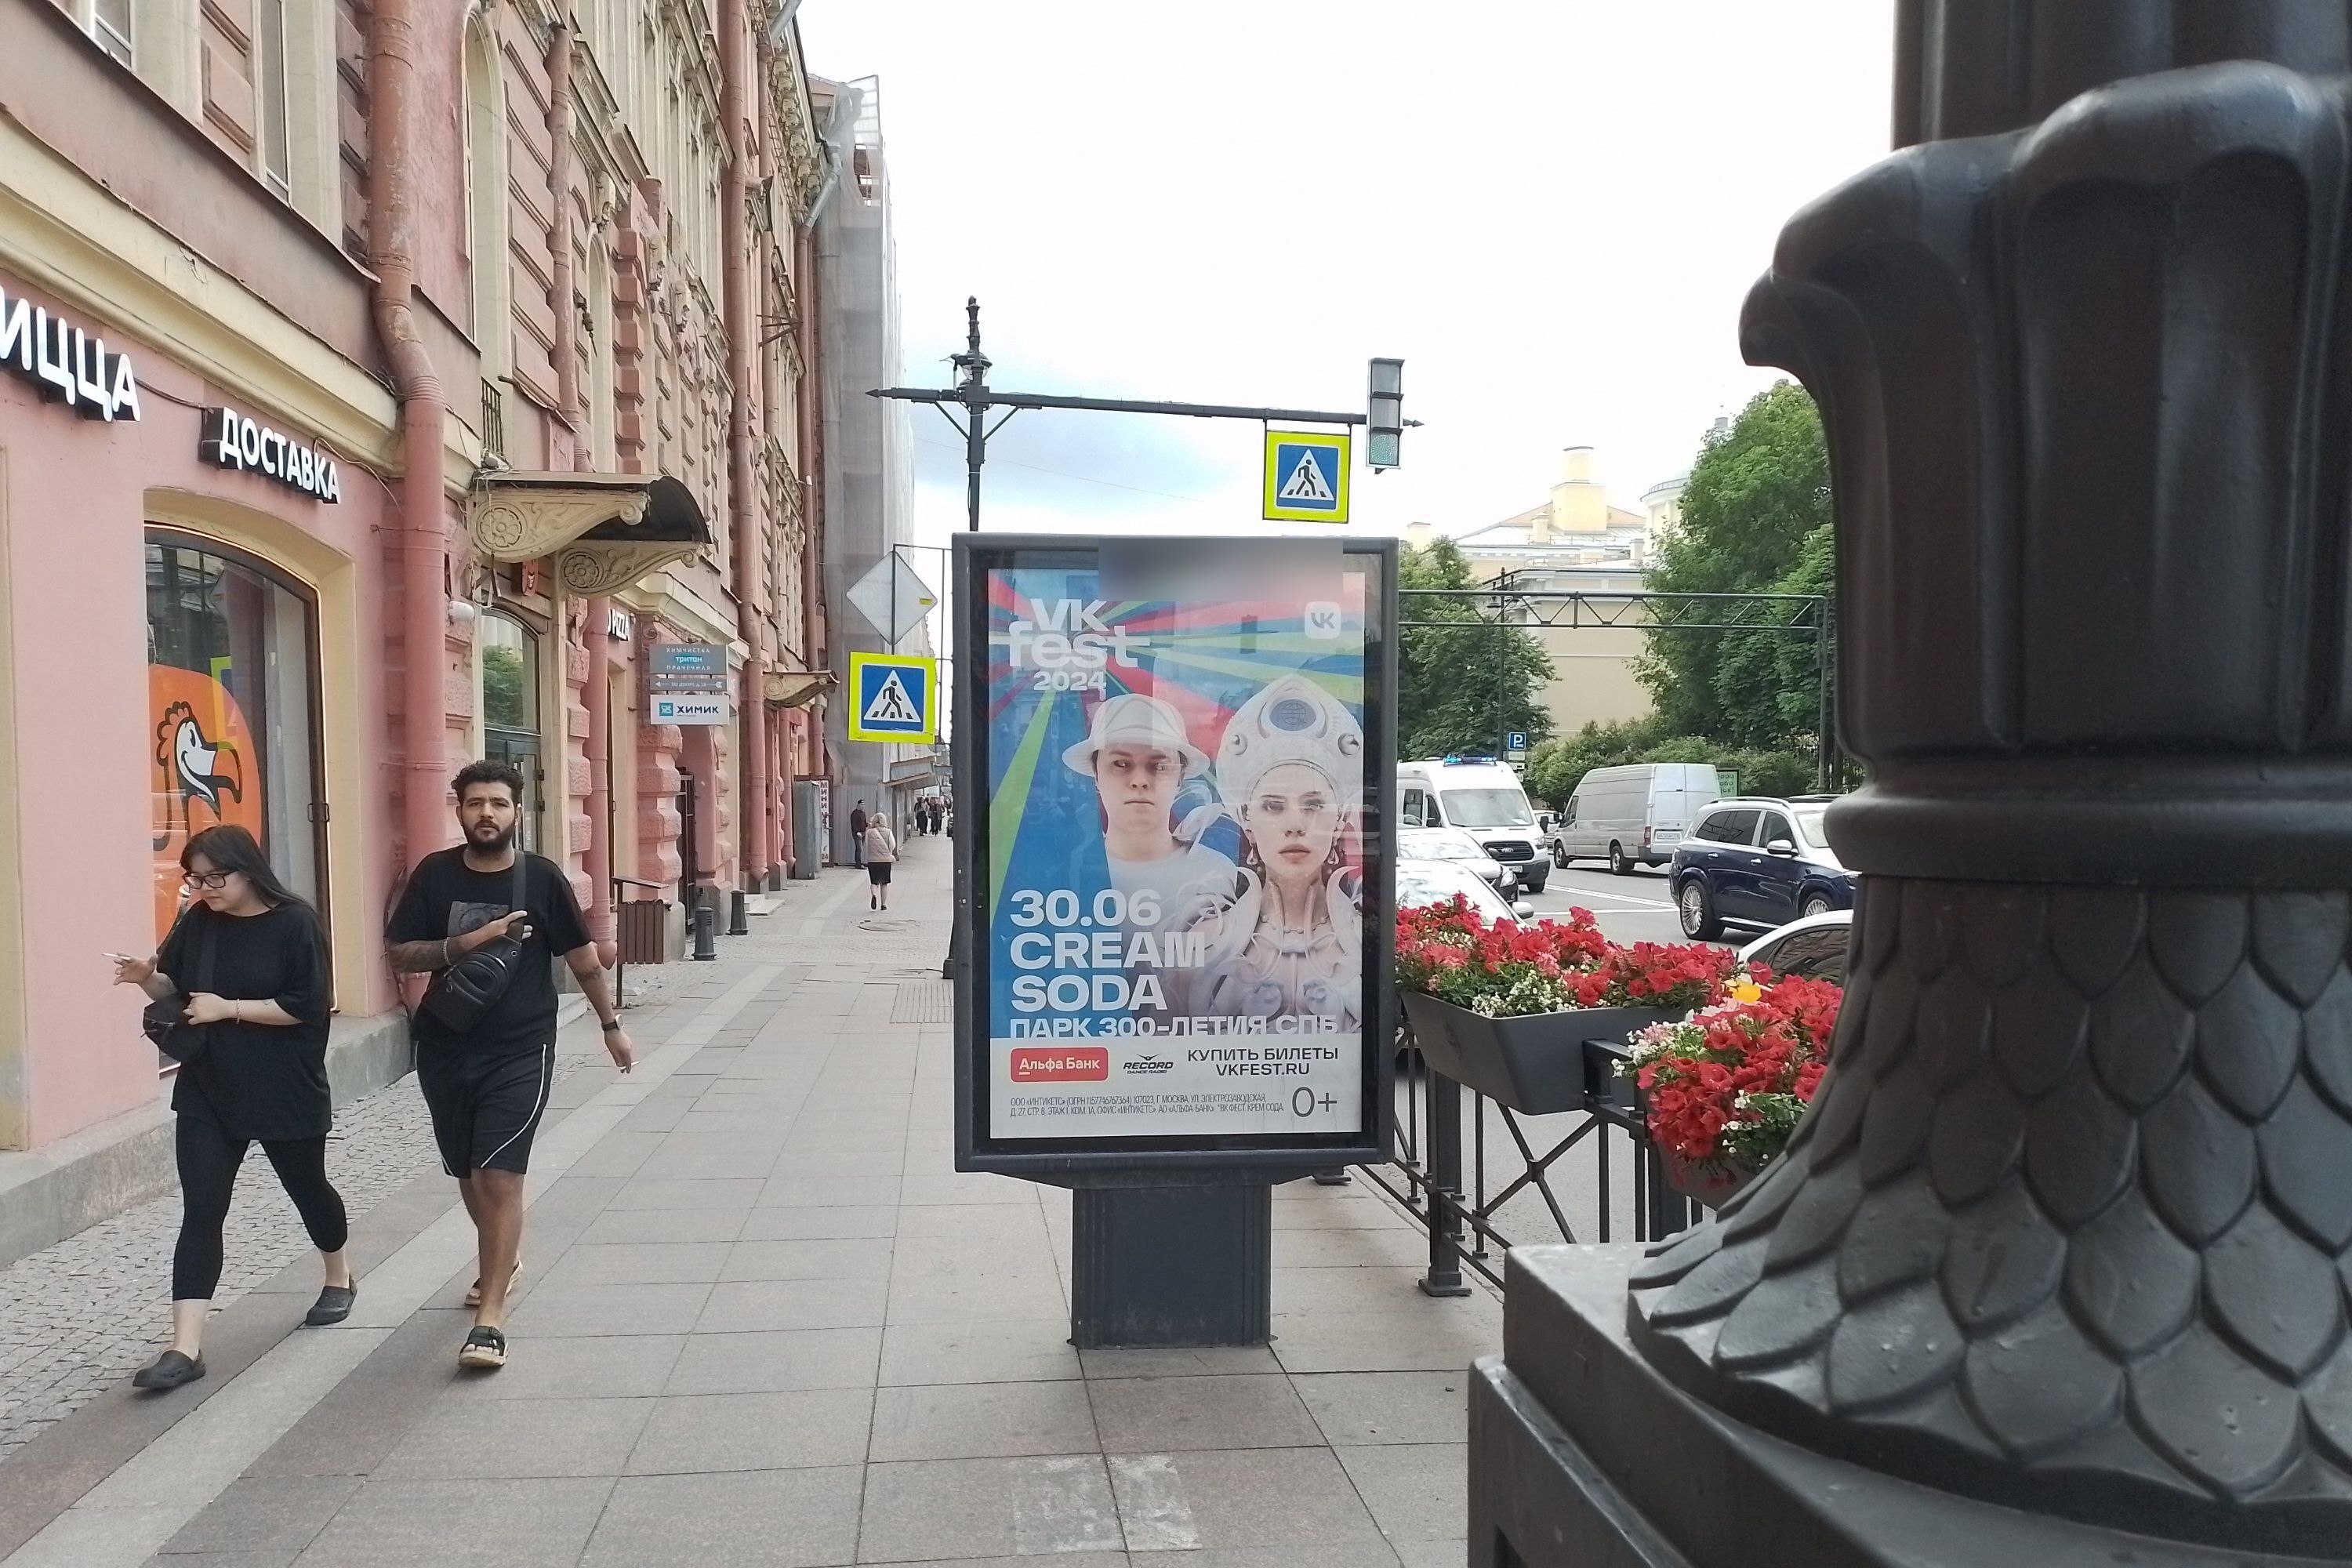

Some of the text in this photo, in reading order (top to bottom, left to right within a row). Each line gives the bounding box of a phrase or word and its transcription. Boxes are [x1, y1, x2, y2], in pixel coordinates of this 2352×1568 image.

[0, 285, 141, 422] ИЦЦА
[220, 407, 341, 504] ДОСТАВКА
[1030, 599, 1110, 632] VK
[1311, 612, 1335, 628] VK
[1009, 621, 1150, 667] fest
[1034, 671, 1106, 700] 2024
[677, 706, 719, 714] ХИМИК
[1514, 735, 1523, 747] P
[1010, 889, 1161, 927] 30.06
[1010, 931, 1205, 970] CREAM
[1011, 975, 1168, 1012] SODA
[1010, 1014, 1339, 1039] ПАРК 300-ЛЕТИЯ СПБ
[1019, 1057, 1100, 1073] Альфа Банк
[1188, 1047, 1338, 1062] КУПИТЬ БИЛЕТЫ
[1216, 1063, 1310, 1076] VKFEST.RU
[1011, 1098, 1025, 1106] ООО
[1067, 1096, 1086, 1107] (ОГРН
[1047, 1106, 1065, 1115] ЭТАЖ
[1097, 1105, 1116, 1114] ОФИС
[1159, 1105, 1167, 1113] АО
[1247, 1103, 1265, 1112] КРЕМ
[1292, 1087, 1338, 1117] 0+
